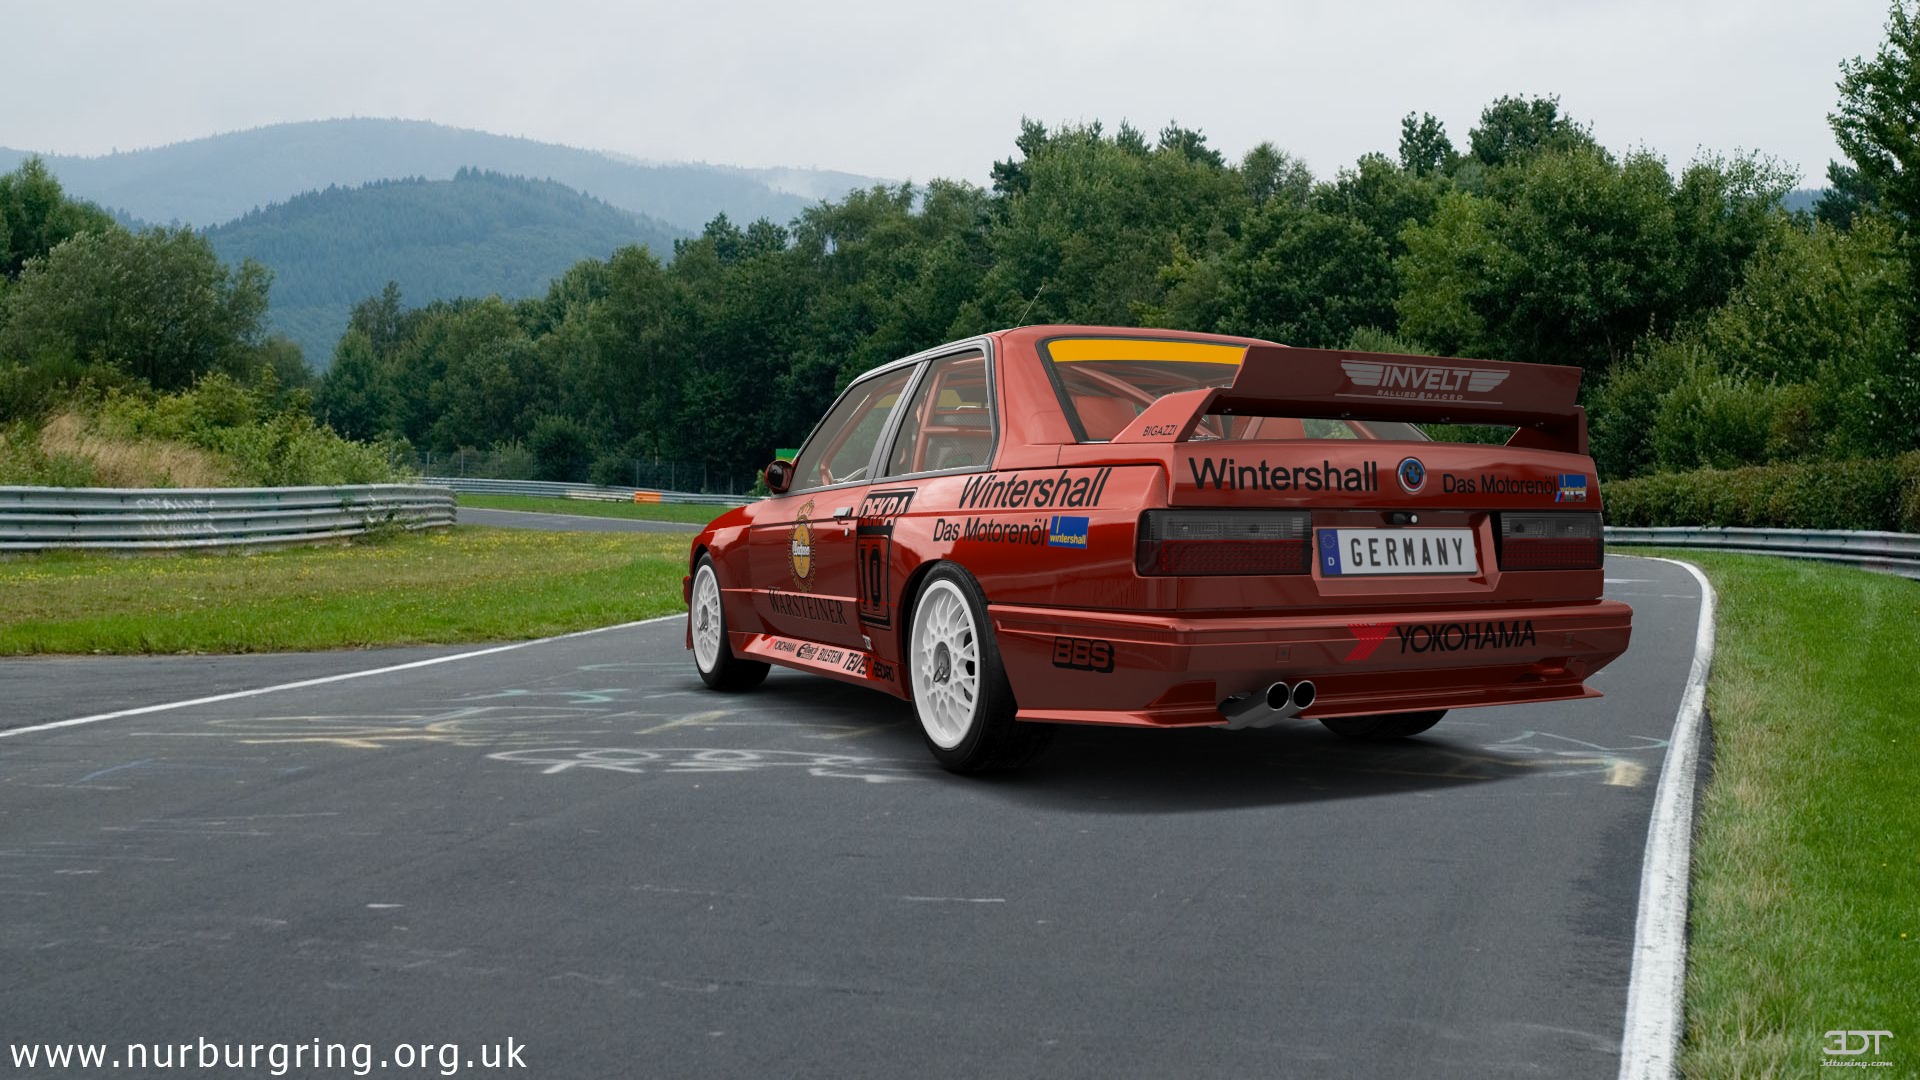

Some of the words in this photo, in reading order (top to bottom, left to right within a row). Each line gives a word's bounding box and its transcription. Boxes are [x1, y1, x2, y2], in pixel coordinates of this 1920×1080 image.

[1381, 365, 1470, 391] INVELT
[1142, 424, 1178, 437] BIGAZZI
[958, 467, 1112, 509] Wintershall
[1188, 457, 1379, 493] Wintershall
[1442, 473, 1476, 494] Das
[1480, 474, 1557, 495] Motorenöl
[858, 495, 909, 527] DEKRA
[932, 518, 960, 543] Das
[963, 517, 1048, 546] Motorenöl
[1049, 533, 1087, 545] wintershall
[1327, 556, 1335, 566] D
[1350, 537, 1463, 567] GERMANY
[859, 544, 881, 612] 10
[768, 588, 847, 625] WARSTEINER
[1396, 619, 1537, 654] YOKOHAMA
[816, 647, 845, 665] BILSTEIN
[842, 652, 872, 675] TEVES
[1052, 636, 1115, 673] BBS
